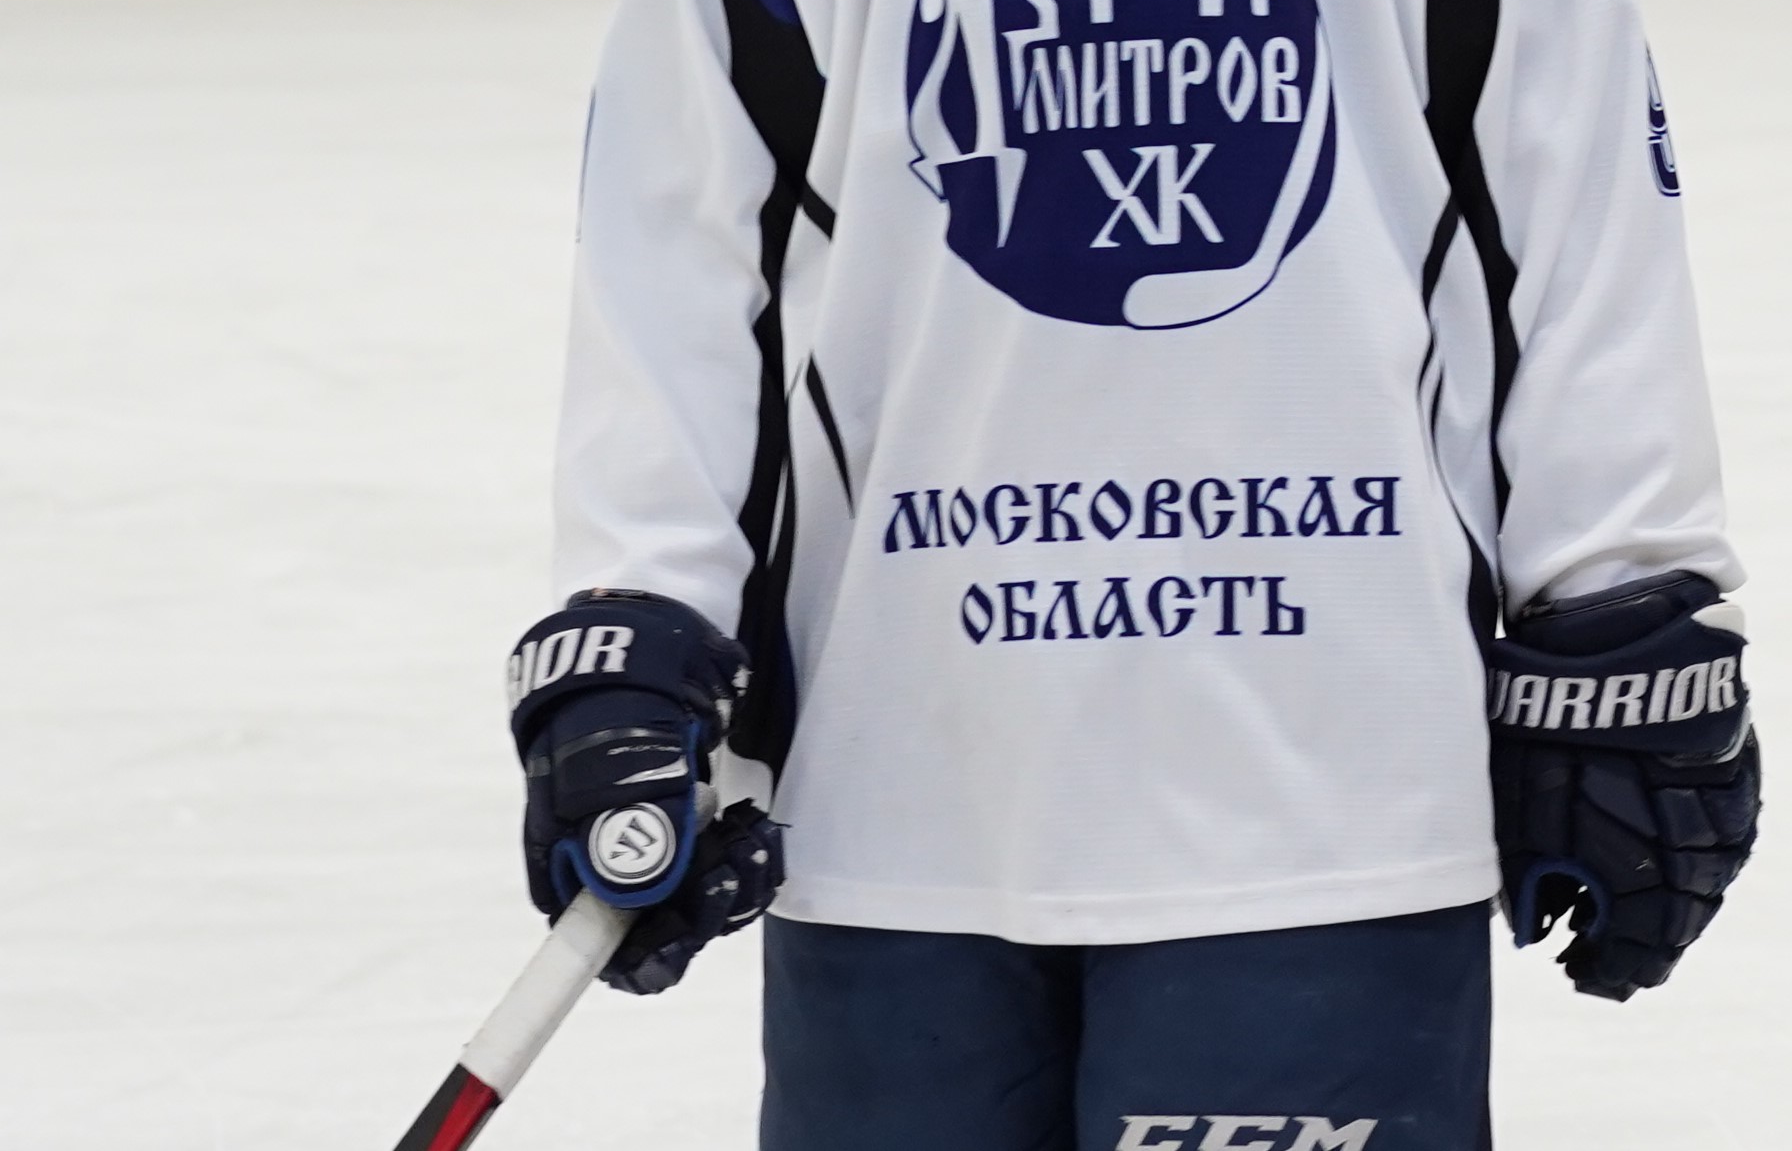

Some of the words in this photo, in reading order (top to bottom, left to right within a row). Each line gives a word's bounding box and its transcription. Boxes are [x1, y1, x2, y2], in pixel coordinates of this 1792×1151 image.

[1082, 143, 1225, 248] ХК
[883, 476, 1403, 553] МОСКОВСКАЯ
[962, 576, 1306, 645] ОБЛАСТЬ
